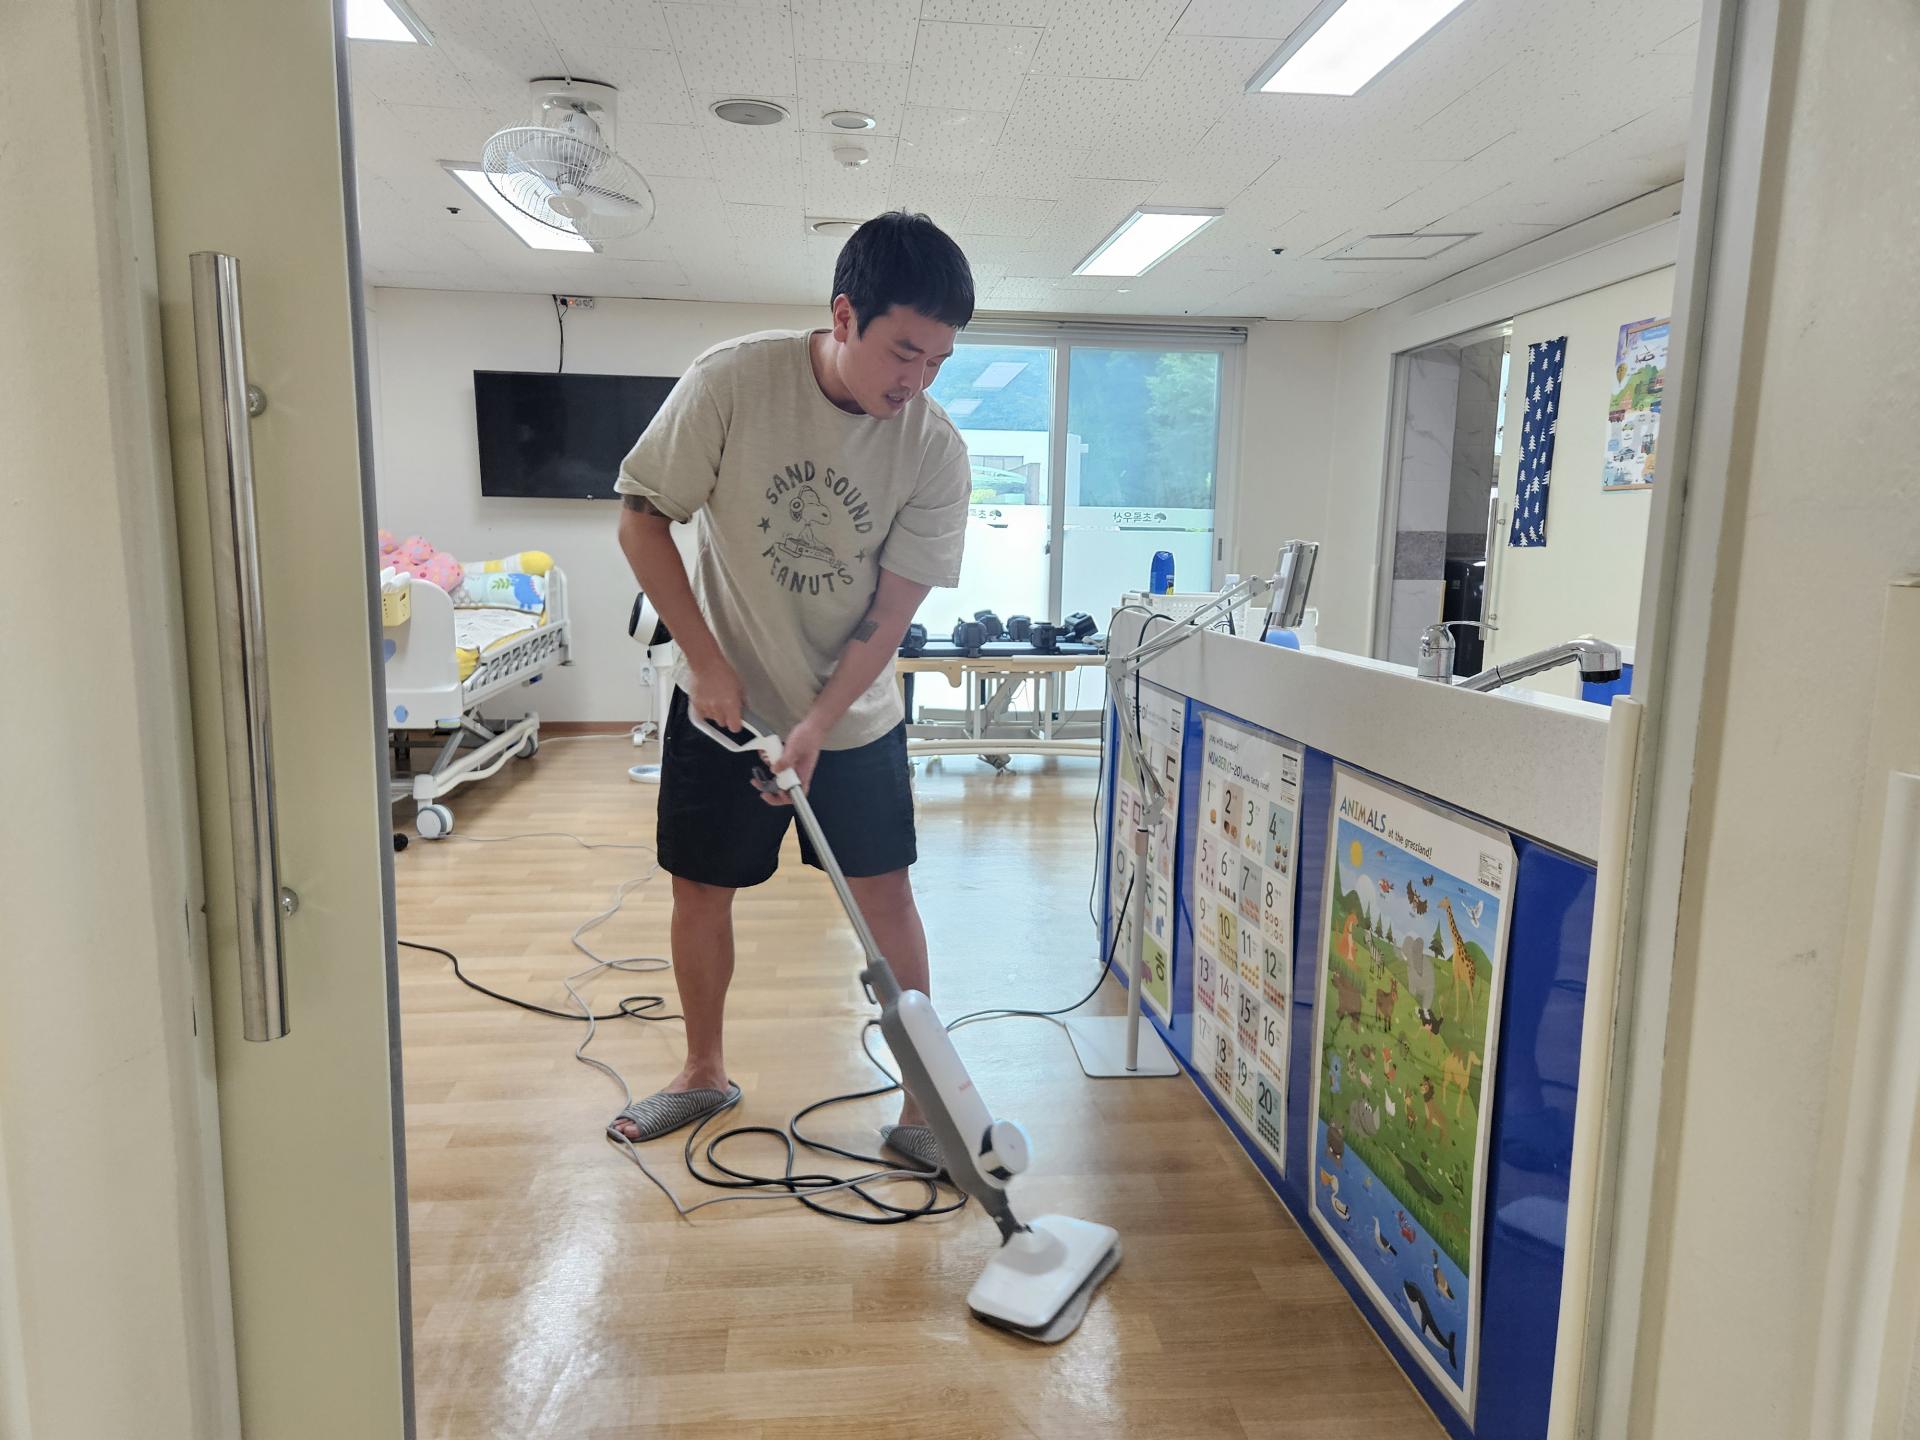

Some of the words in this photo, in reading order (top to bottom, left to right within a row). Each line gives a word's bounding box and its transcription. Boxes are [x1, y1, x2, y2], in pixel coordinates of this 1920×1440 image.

[766, 460, 816, 505] SAND
[824, 467, 873, 534] SOUND
[762, 545, 854, 596] PEANUTS
[1225, 789, 1232, 815] 2
[1246, 800, 1254, 826] 3
[1268, 812, 1277, 840] 4
[1340, 795, 1387, 833] ANIMALS
[1388, 829, 1394, 839] at
[1395, 830, 1404, 844] the
[1404, 838, 1433, 860] grassland!
[1201, 839, 1208, 862] 5
[1221, 851, 1228, 876] 6
[1242, 865, 1250, 891] 7
[1199, 896, 1206, 920] 9
[1265, 881, 1274, 908] 8
[1219, 912, 1231, 940] 10
[1241, 929, 1251, 958] 11
[1199, 955, 1209, 982] 13
[1264, 948, 1277, 979] 12
[1220, 973, 1230, 1002] 14
[1240, 993, 1251, 1024] 15
[1198, 1014, 1207, 1040] 17
[1263, 1015, 1275, 1047] 16
[1216, 1033, 1227, 1063] 18
[1237, 1057, 1248, 1087] 19
[1258, 1081, 1273, 1115] 20
